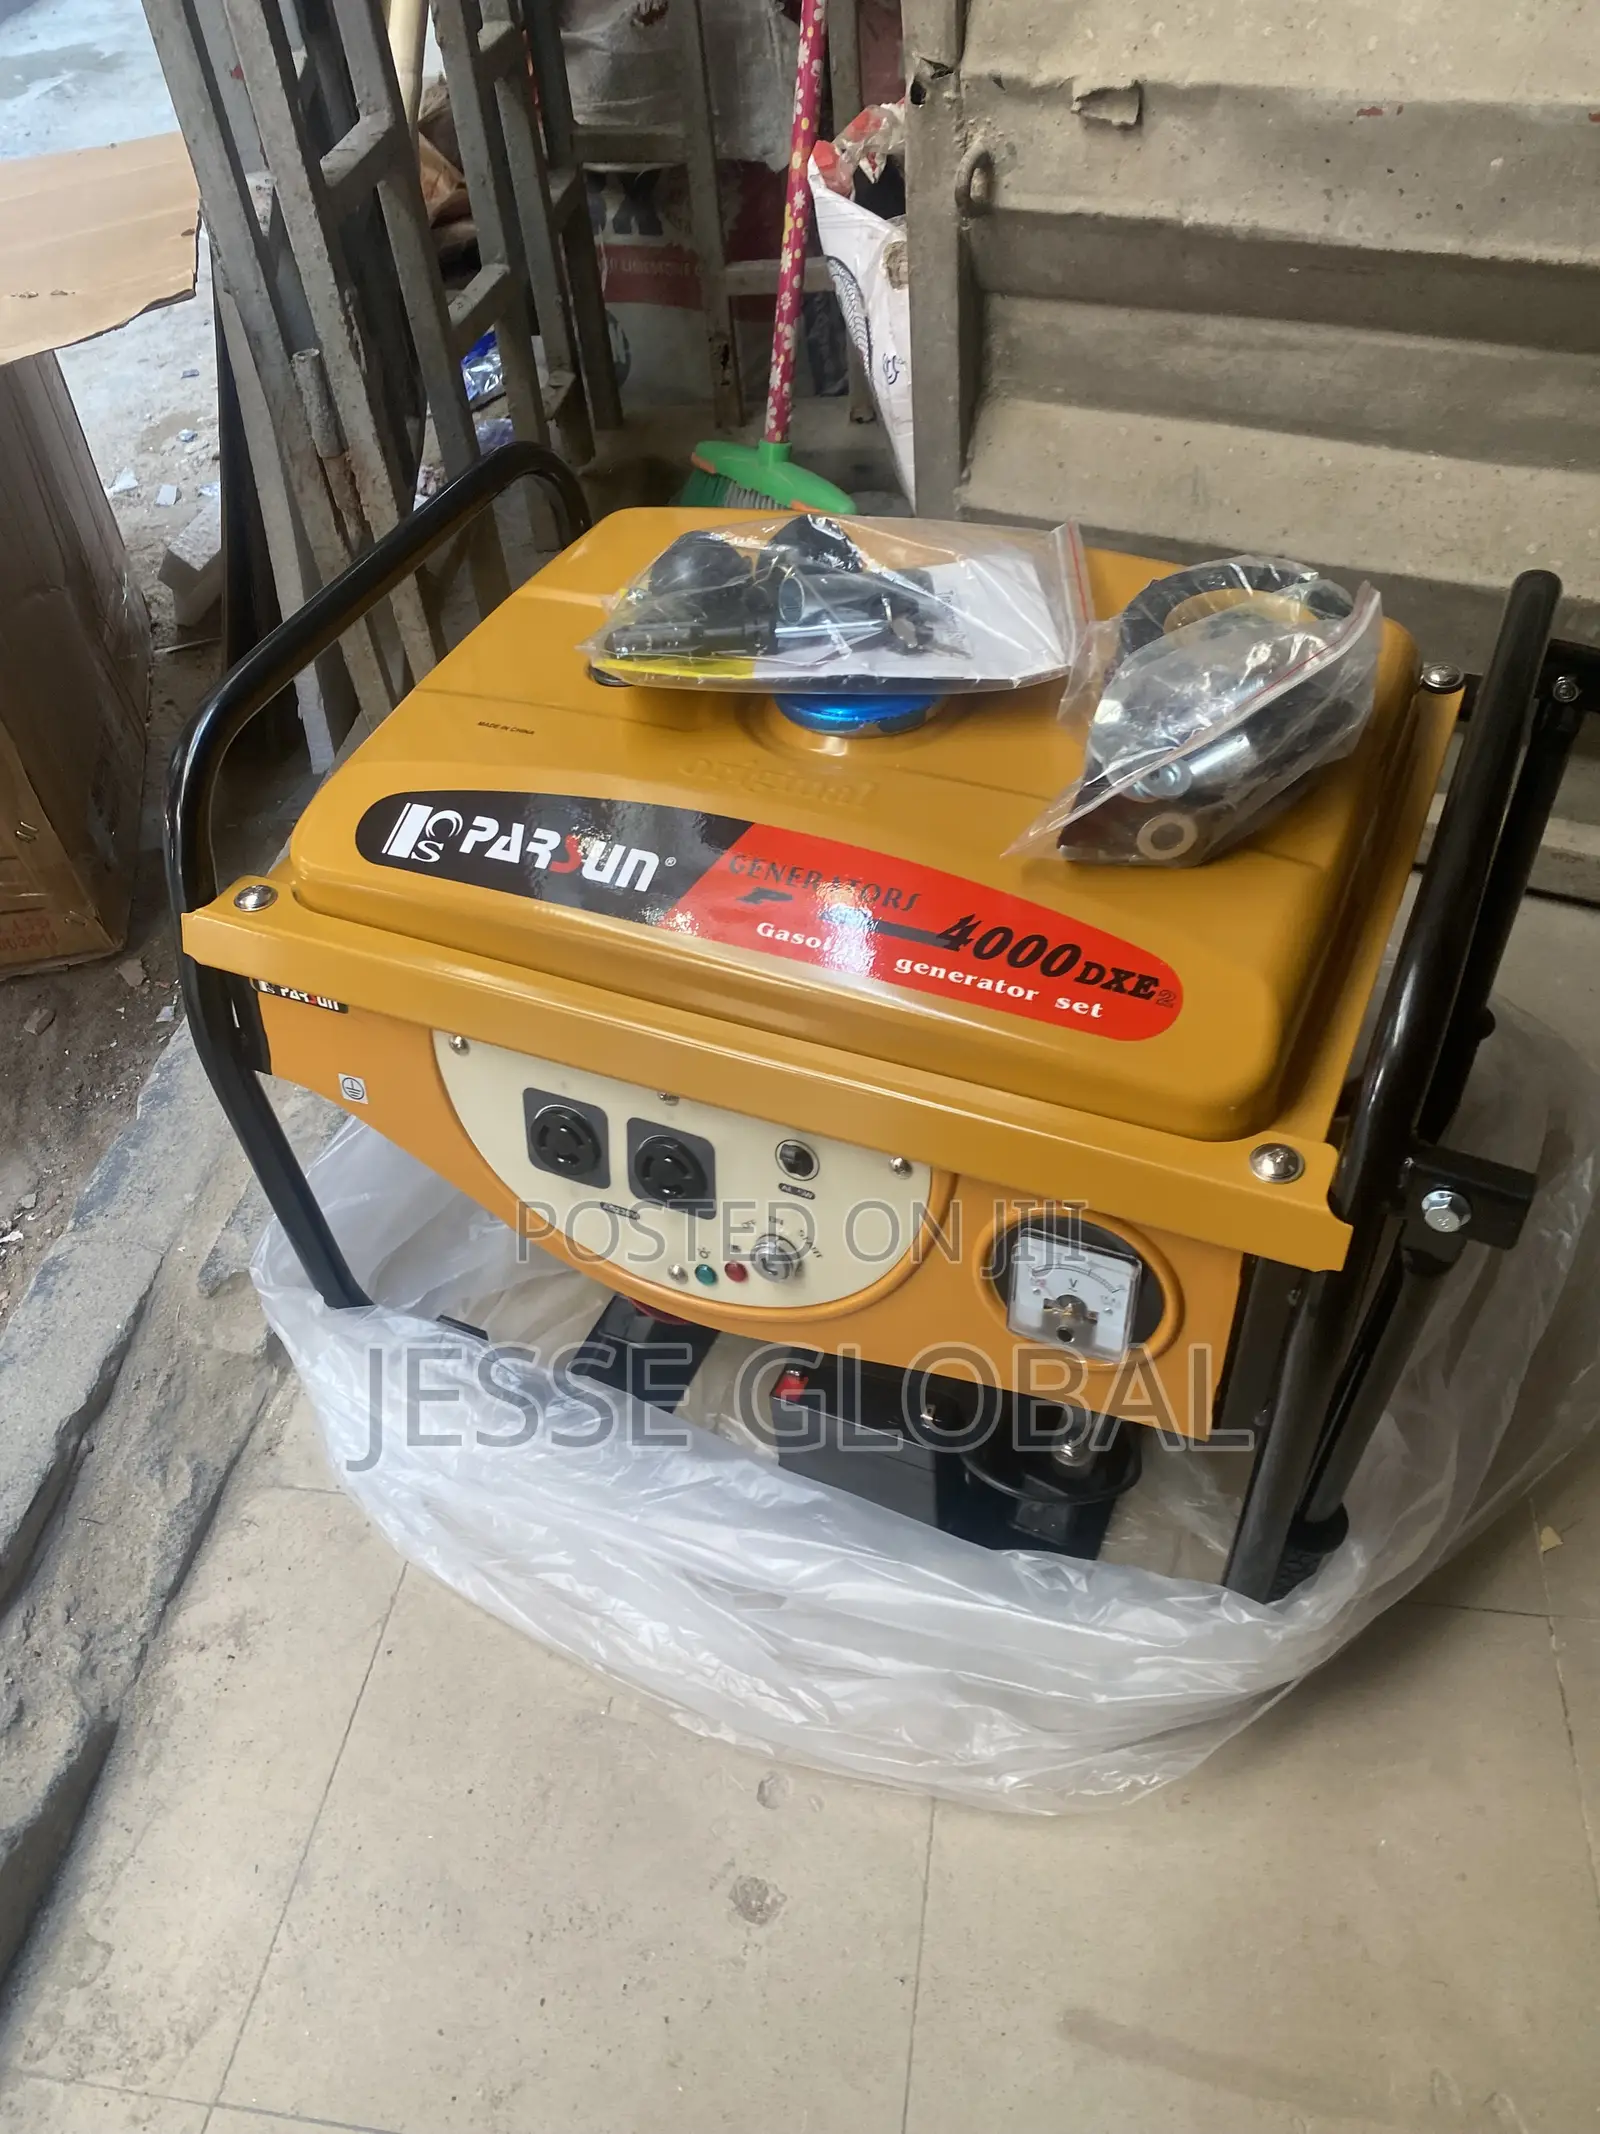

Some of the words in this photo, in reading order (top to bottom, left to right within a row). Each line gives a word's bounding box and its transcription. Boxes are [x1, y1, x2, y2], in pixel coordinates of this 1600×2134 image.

[729, 854, 922, 912] GENERATORS
[893, 958, 1040, 1001] generator
[1054, 996, 1103, 1019] set
